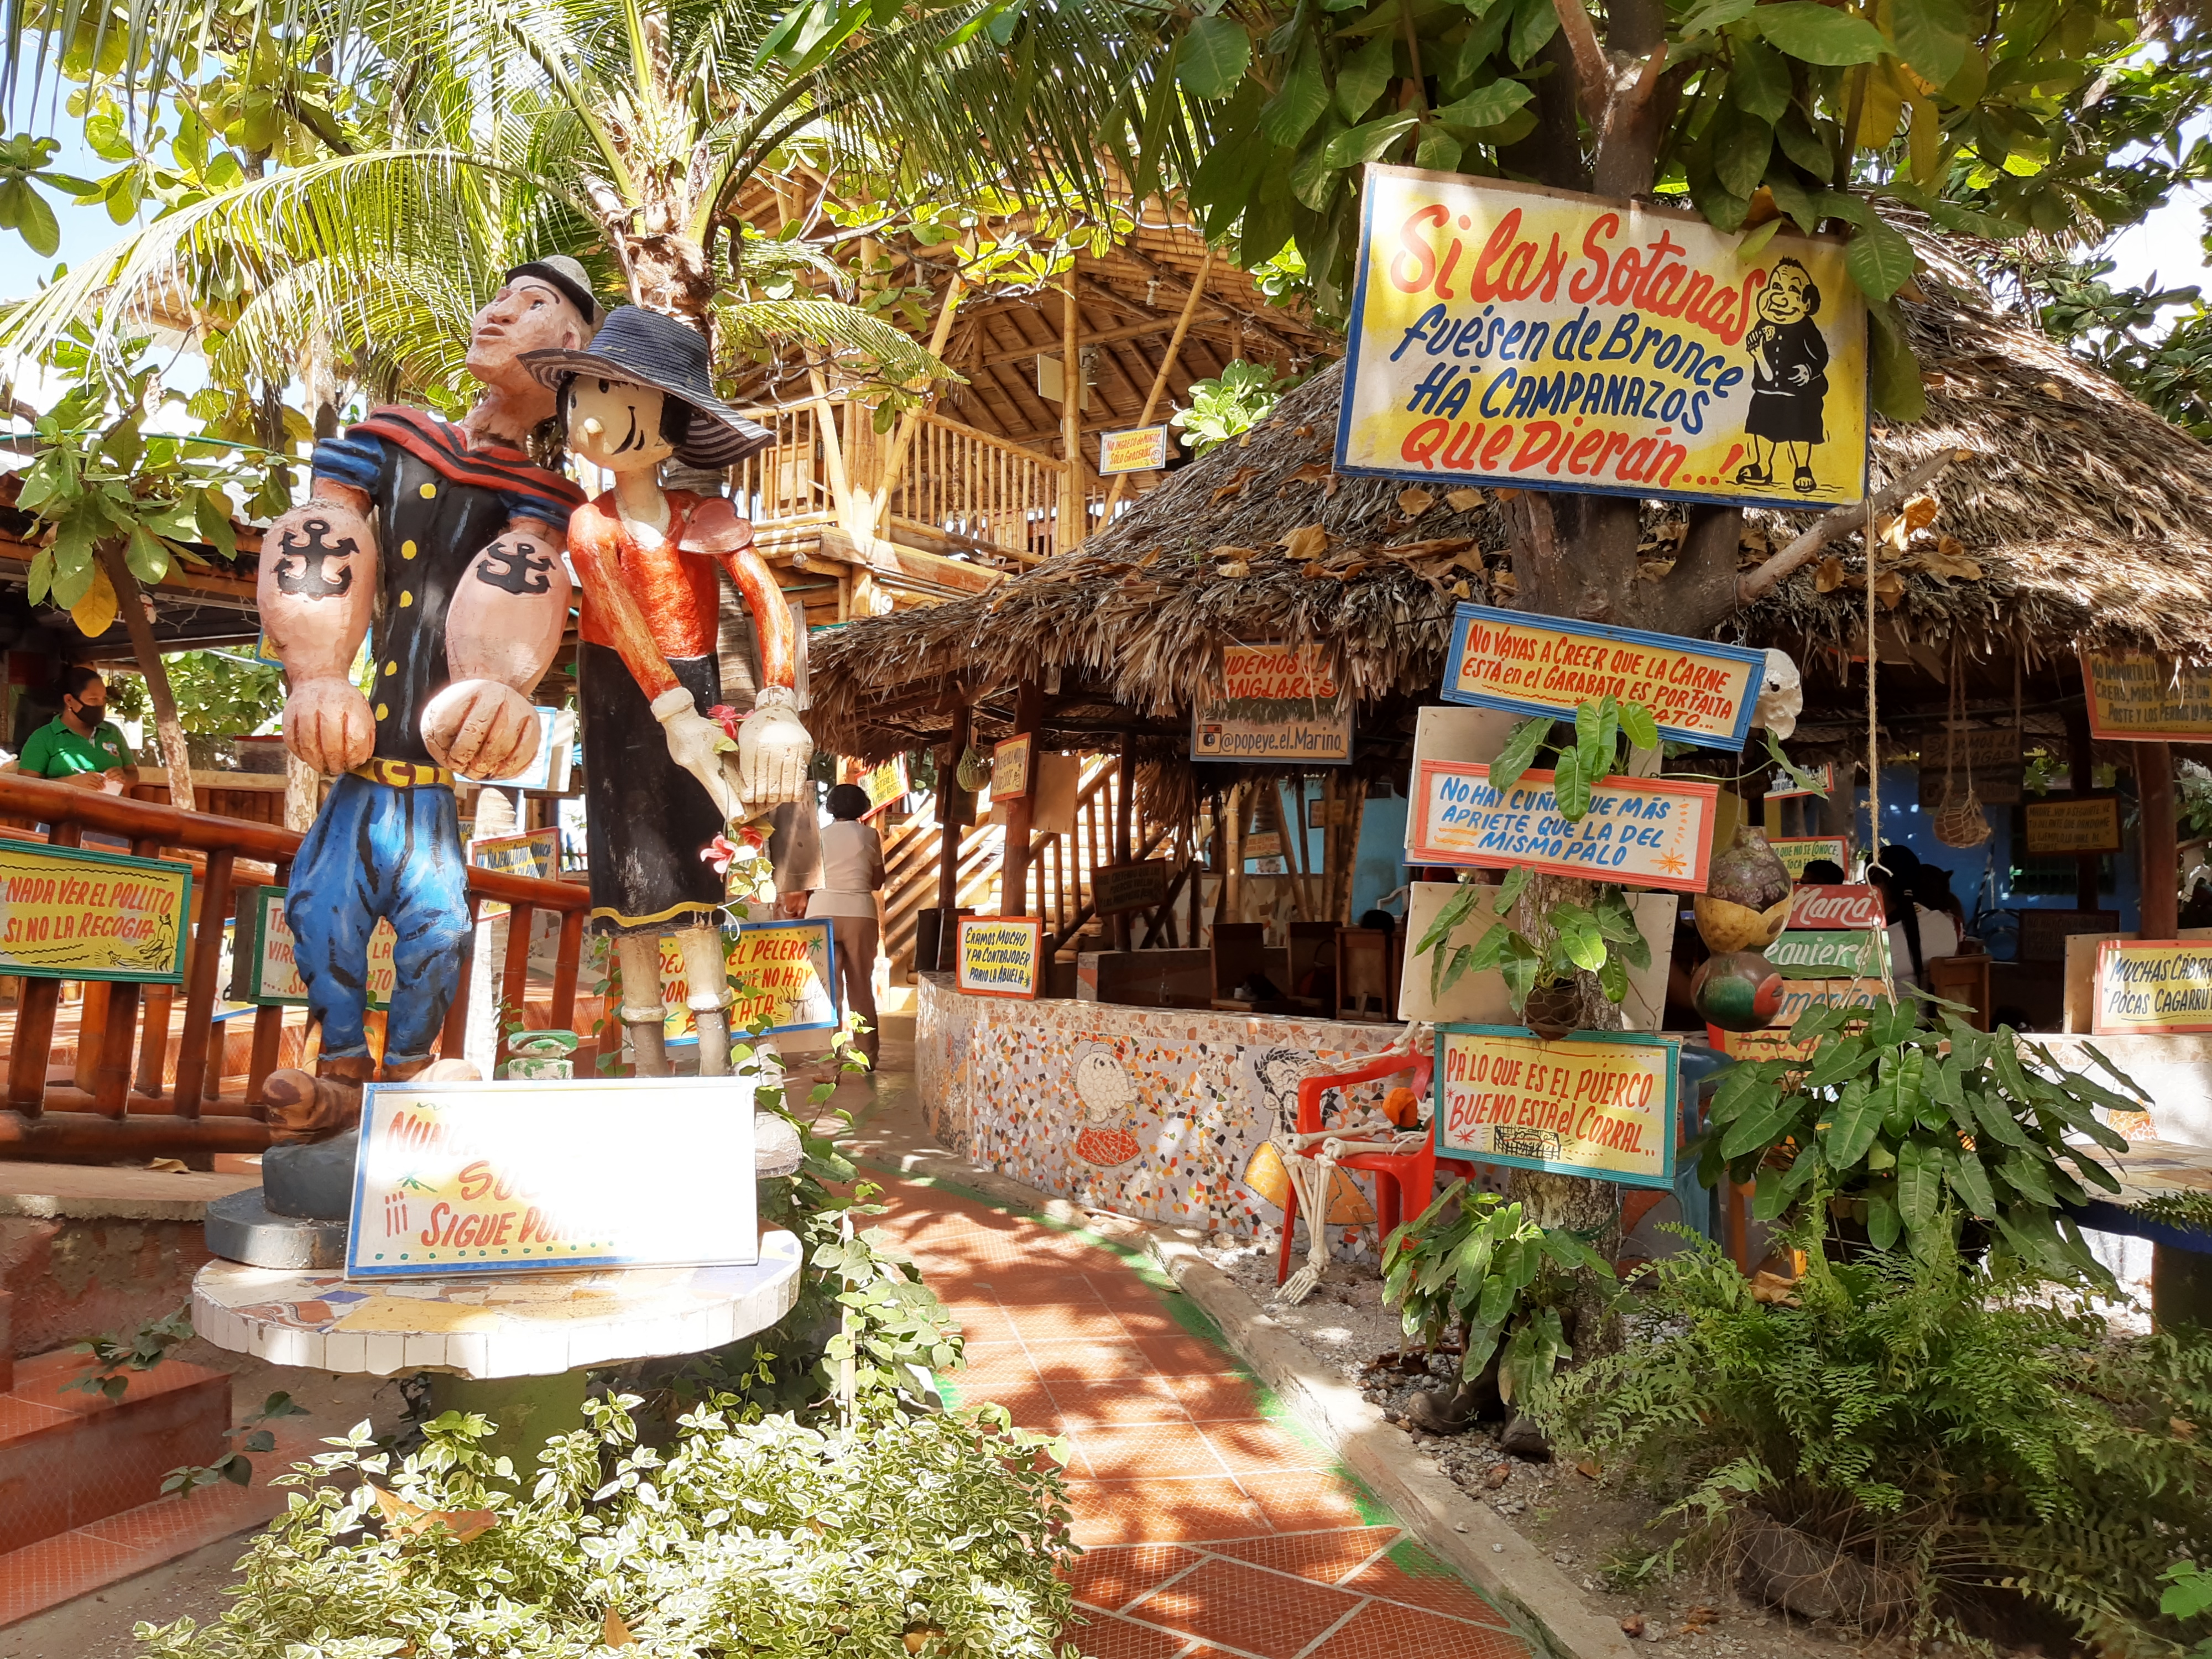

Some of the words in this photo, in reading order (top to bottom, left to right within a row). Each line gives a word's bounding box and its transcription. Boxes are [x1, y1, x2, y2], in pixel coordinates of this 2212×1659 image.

[1390, 204, 1472, 300] Si
[1470, 207, 1568, 304] las
[1568, 212, 1767, 346] Sotanas
[1551, 306, 1601, 362] de
[1600, 312, 1744, 399] Bronce
[1480, 368, 1710, 435] CAMPANAZOS
[1110, 451, 1124, 465] SÓLO
[1115, 437, 1136, 450] INGRESO
[1137, 436, 1143, 446] de
[1400, 418, 1512, 471] Que
[1467, 623, 1491, 653] NO
[1494, 627, 1537, 662] VAYAS
[1540, 640, 1551, 659] A
[1553, 636, 1608, 670] CREER
[1610, 650, 1644, 674] QUE
[1646, 657, 1667, 679] LA
[1668, 656, 1731, 694] CARNE
[1212, 677, 1337, 698] ANGLARES
[1504, 667, 1522, 685] en
[1524, 669, 1540, 688] el
[1543, 665, 1625, 698] GARABATO
[1629, 682, 1650, 701] ES
[1652, 686, 1689, 709] POR
[1688, 690, 1733, 720] FALTA
[2109, 703, 2133, 723] POSTE
[2144, 708, 2157, 722] LOS
[1221, 726, 1341, 754] @popeye.el.Marino
[1440, 777, 1469, 802] NO
[1470, 785, 1505, 808] HAY
[1587, 796, 1618, 815] UE
[1441, 805, 1528, 832] APRIETE
[1537, 816, 1580, 836] QUE
[1584, 821, 1612, 841] LA
[1619, 825, 1666, 848] DEL
[1478, 831, 1562, 860] MISMO
[1563, 840, 1627, 866] PALO
[1780, 845, 1792, 858] QUE
[5, 876, 56, 904] NADA
[58, 876, 90, 905] VER
[89, 883, 107, 907] EL
[108, 882, 175, 915] POLLITO
[4, 917, 22, 943] SI
[26, 916, 49, 942] NO
[54, 915, 74, 940] LA
[77, 912, 155, 940] RECOGIA
[966, 926, 995, 946] ERAMOS
[996, 929, 1026, 946] MUCHO
[269, 941, 295, 964] VIR
[372, 942, 392, 959] LA
[729, 943, 746, 966] EL
[750, 940, 811, 963] PELERO,
[966, 948, 971, 962] Y
[972, 949, 980, 962] PA
[762, 968, 780, 988] NO
[782, 967, 812, 988] HAY
[969, 967, 988, 982] PARIO
[989, 969, 996, 983] LA
[997, 965, 1024, 984] ABUELA
[2109, 957, 2171, 983] MUCHAS
[1469, 1054, 1488, 1082] LO
[1490, 1056, 1523, 1086] QUE
[1525, 1063, 1548, 1092] ES
[1549, 1067, 1569, 1099] EL
[1449, 1093, 1516, 1131] BUENO
[1557, 1103, 1575, 1135] el
[421, 1202, 517, 1247] SIGUE
